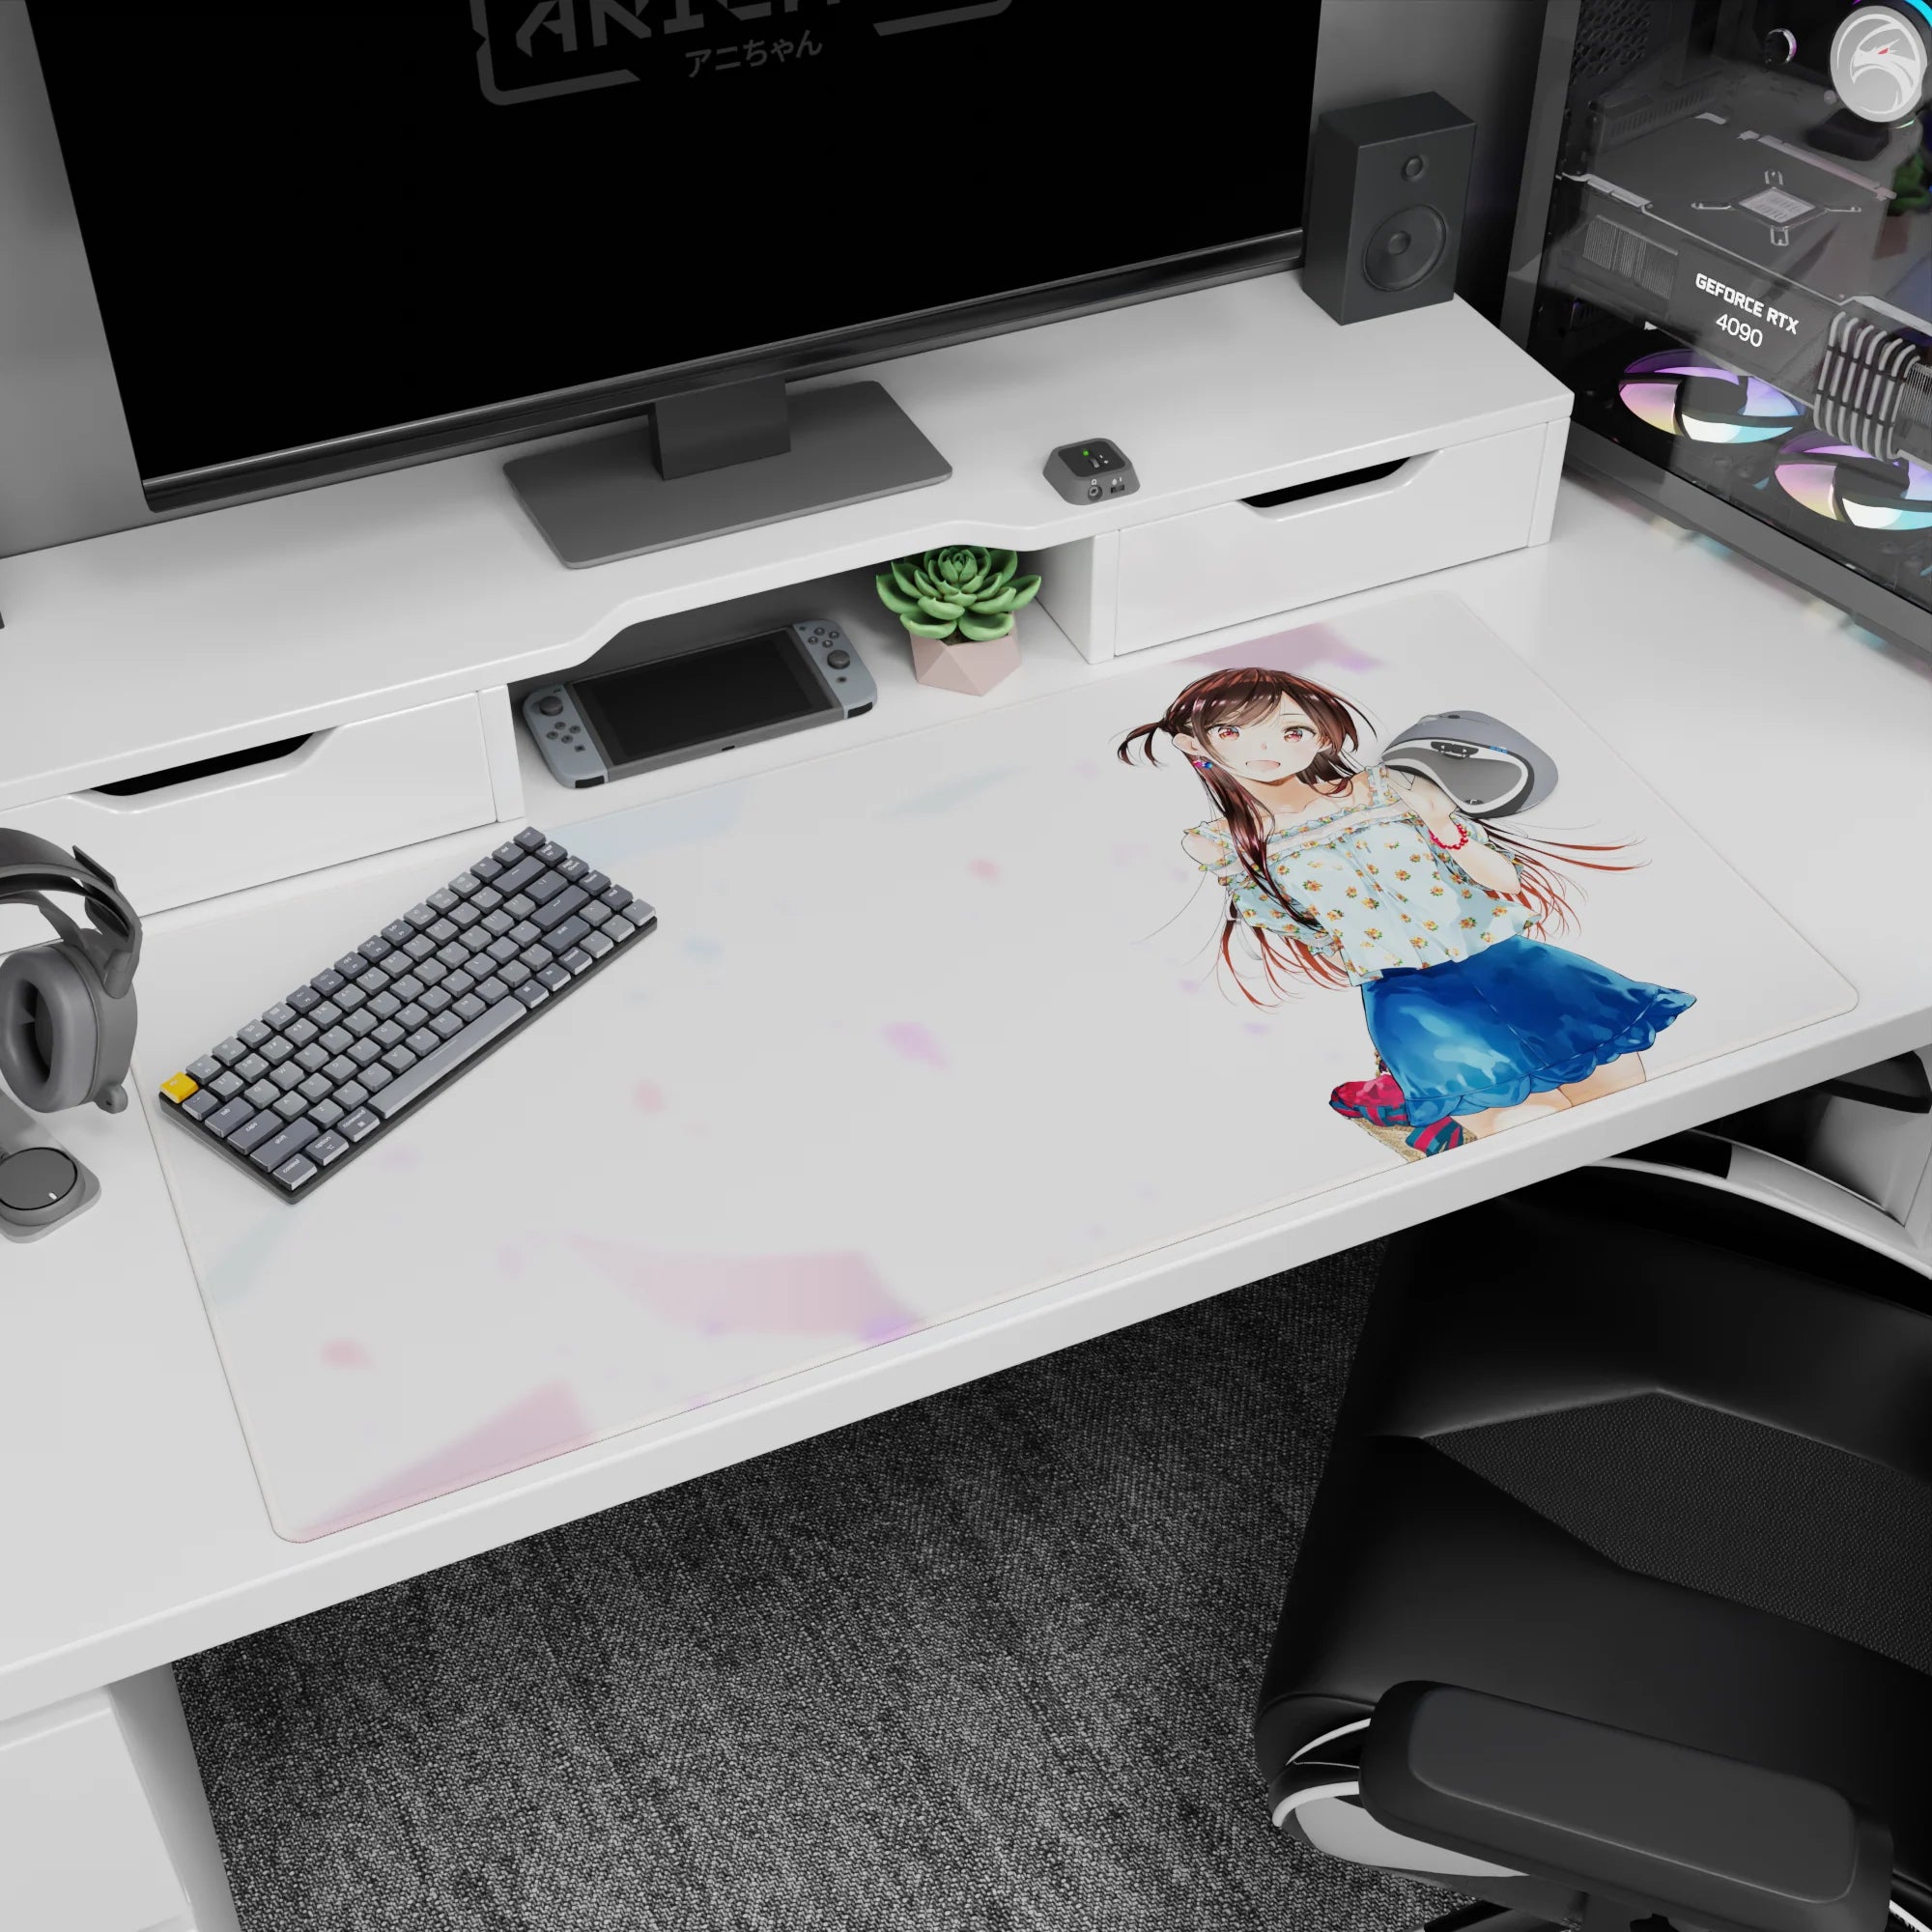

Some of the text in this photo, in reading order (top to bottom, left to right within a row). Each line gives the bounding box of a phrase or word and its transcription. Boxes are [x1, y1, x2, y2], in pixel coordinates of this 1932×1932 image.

[685, 30, 822, 77] アニちゃん
[1695, 273, 1799, 335] GEFORCE RTX
[1716, 314, 1763, 348] 4090
